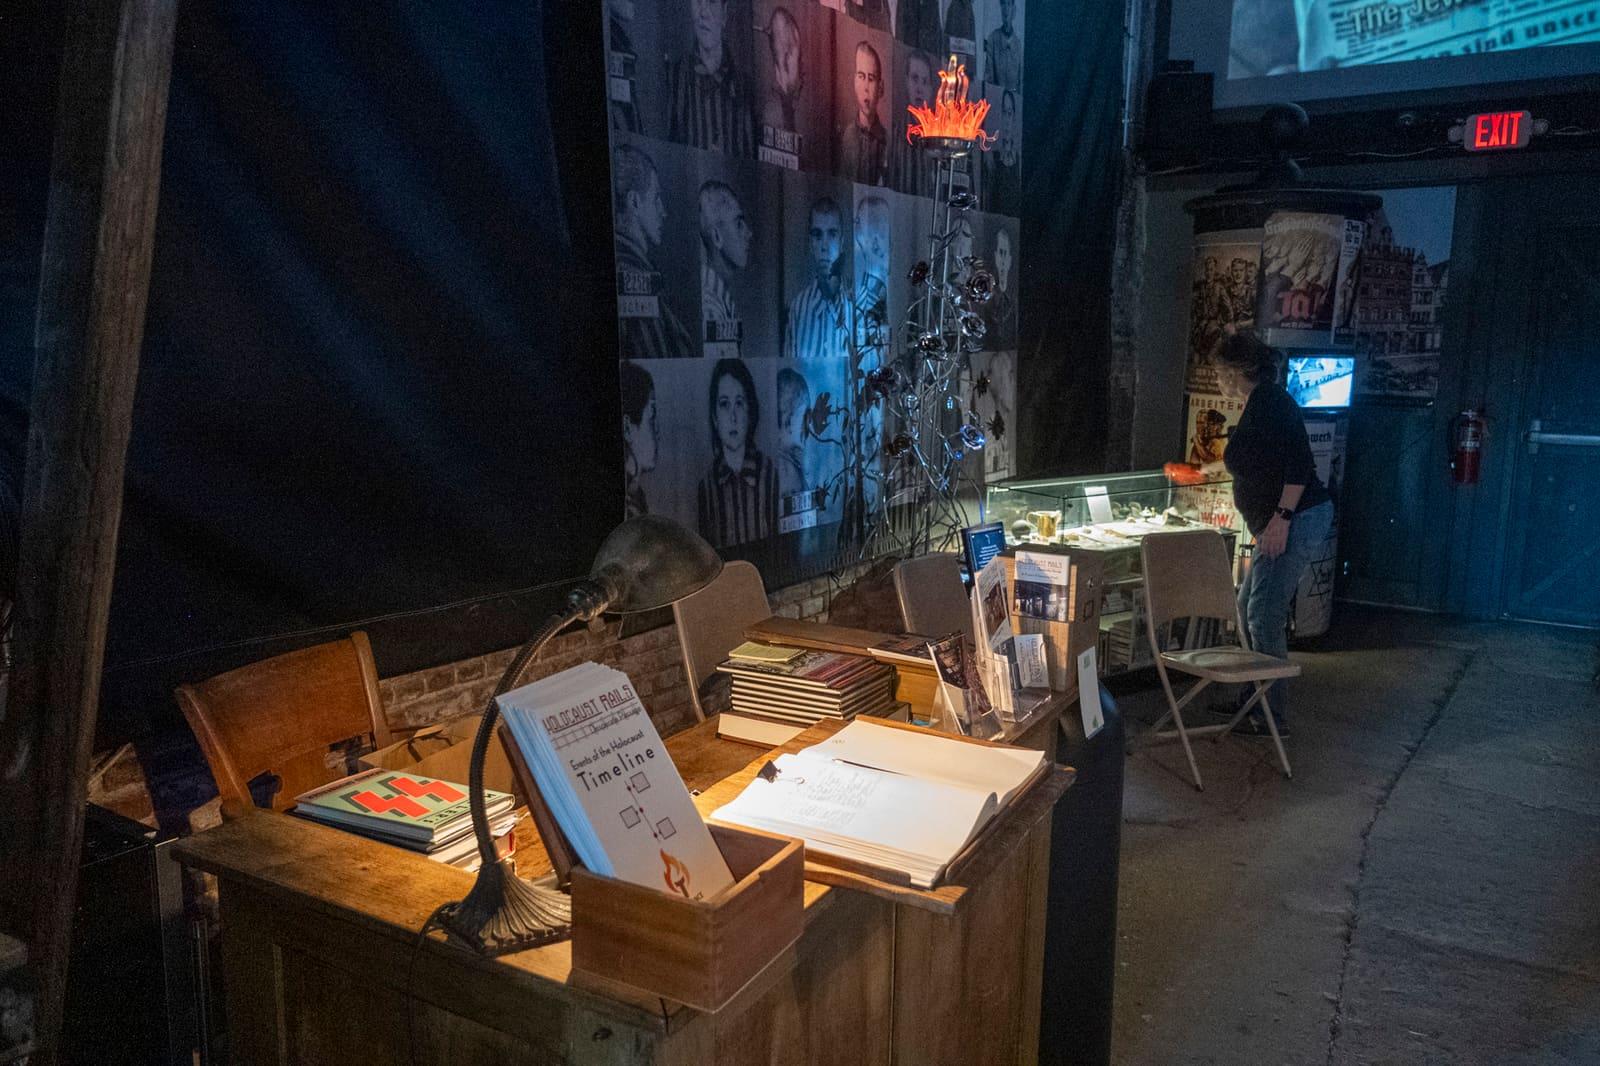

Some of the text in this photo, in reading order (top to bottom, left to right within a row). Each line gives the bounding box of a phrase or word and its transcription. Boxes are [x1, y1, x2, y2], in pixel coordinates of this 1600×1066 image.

[1351, 6, 1398, 34] The
[1474, 112, 1523, 148] EXIT
[542, 684, 634, 735] HOLOCAUST RAILS
[570, 729, 645, 771] Events of the Holocaust
[577, 748, 655, 792] Timeline
